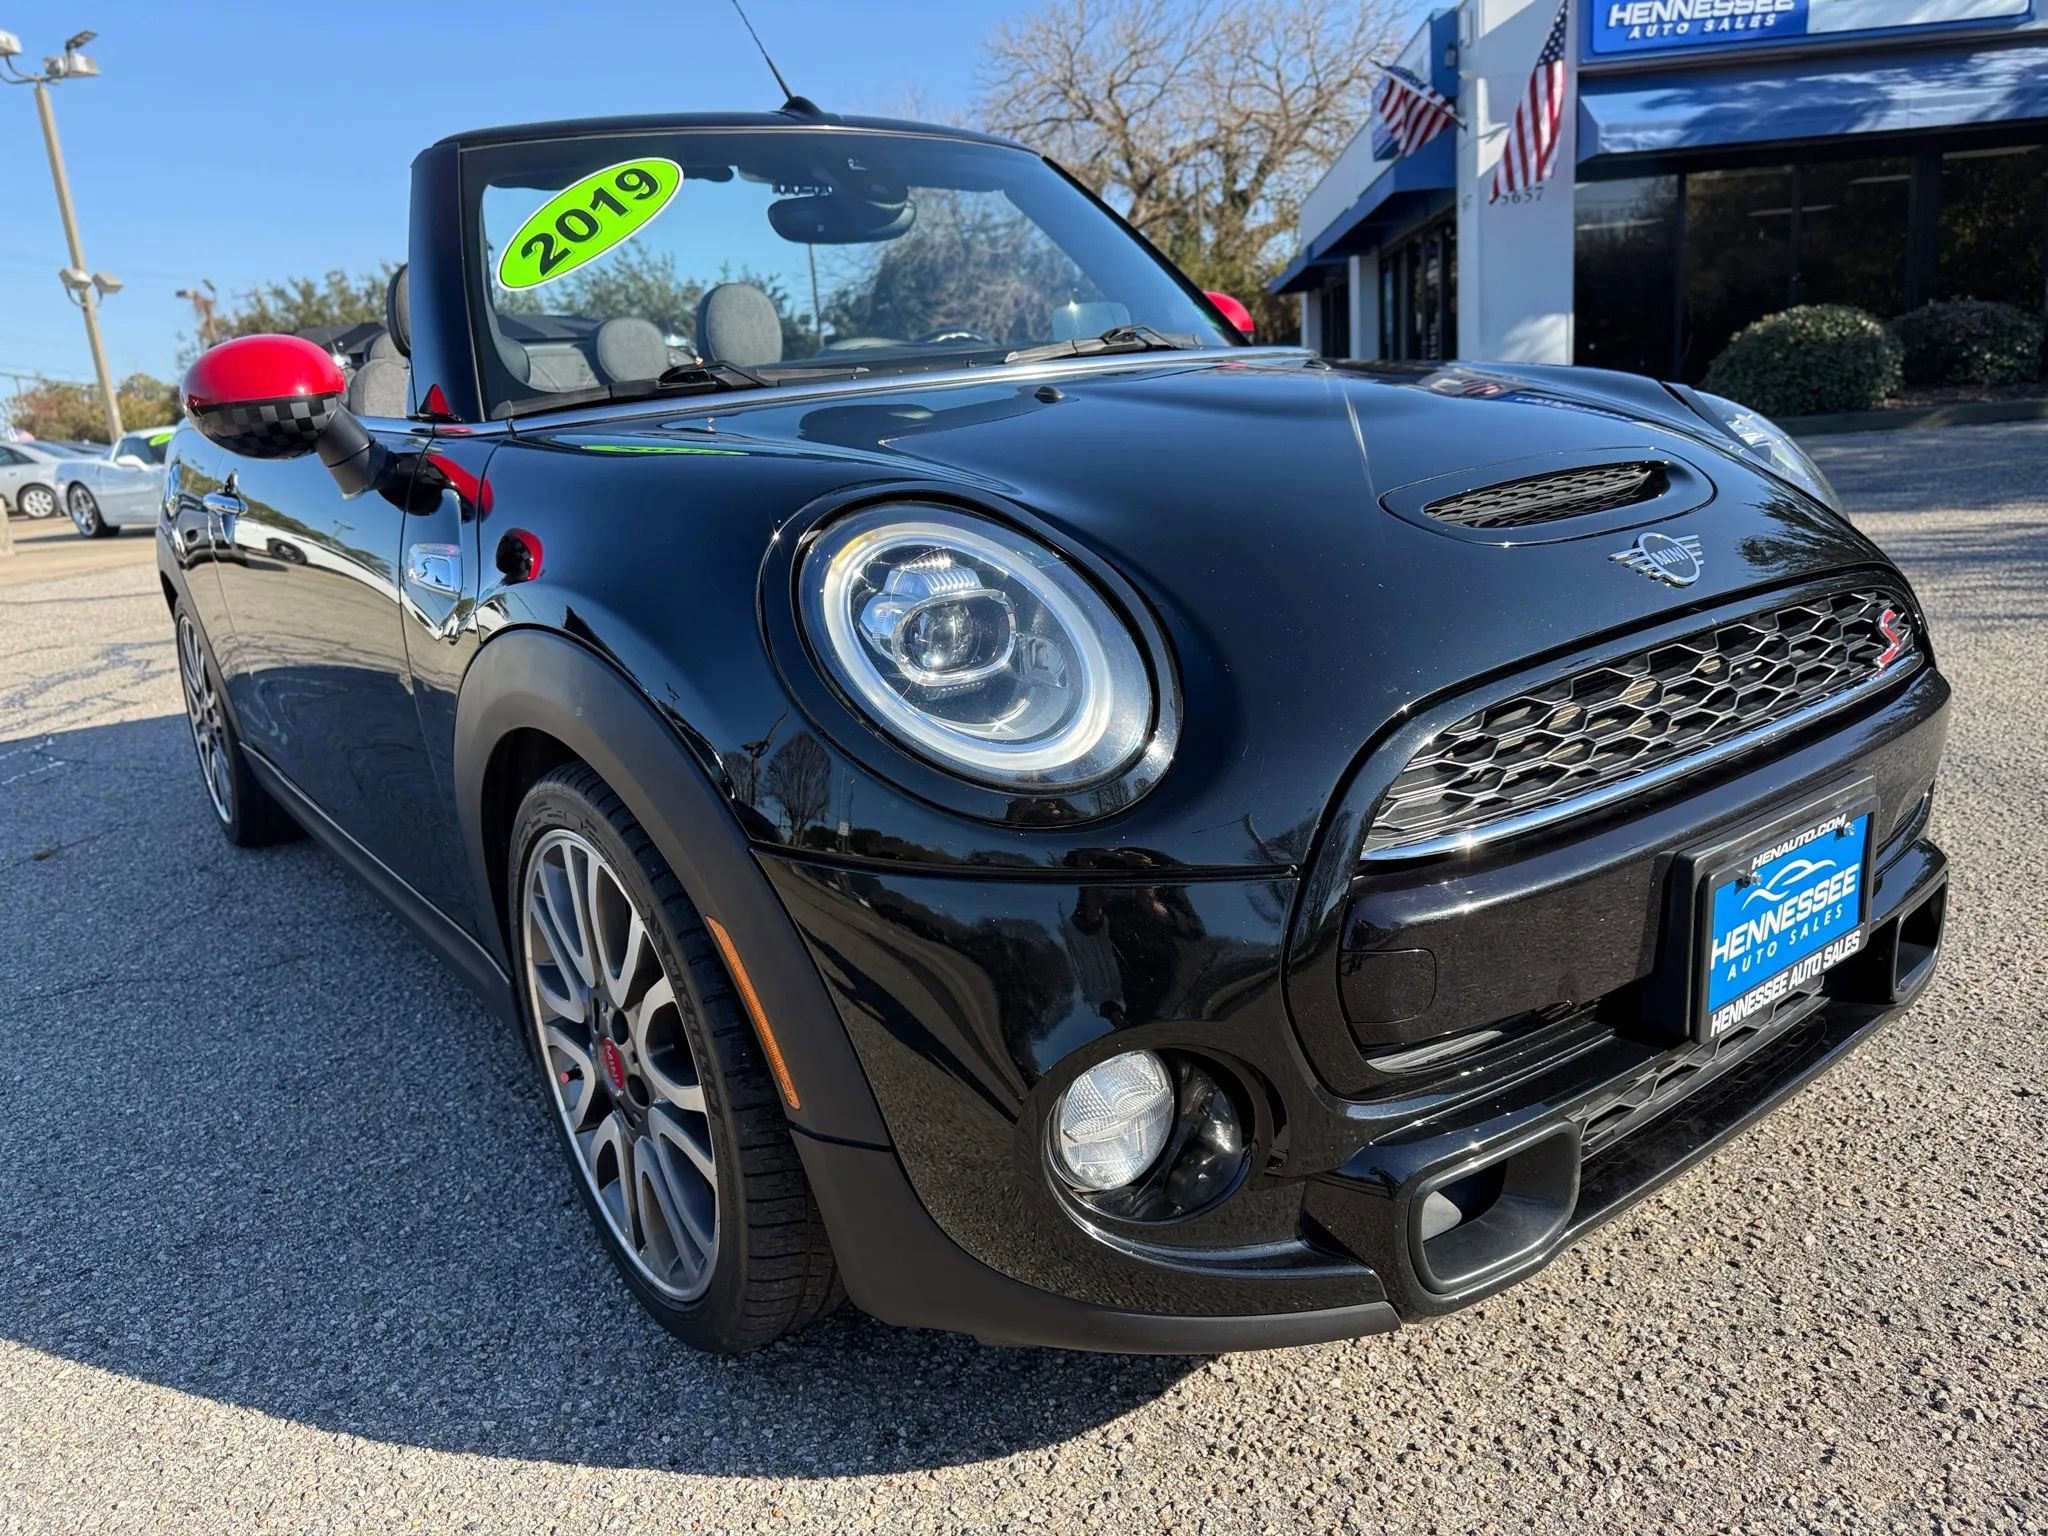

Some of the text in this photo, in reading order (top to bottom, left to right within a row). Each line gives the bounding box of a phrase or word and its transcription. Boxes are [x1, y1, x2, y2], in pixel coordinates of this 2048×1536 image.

[1628, 13, 1777, 39] AUTO SALES
[521, 168, 659, 276] 2019
[1650, 546, 1689, 566] MINI
[1752, 813, 1847, 870] HENAUTO.COM
[1710, 863, 1861, 970] HENNESSEE
[1727, 903, 1843, 982] AUTO SALES
[1710, 929, 1861, 1038] HENNESSEE AUTO SALES
